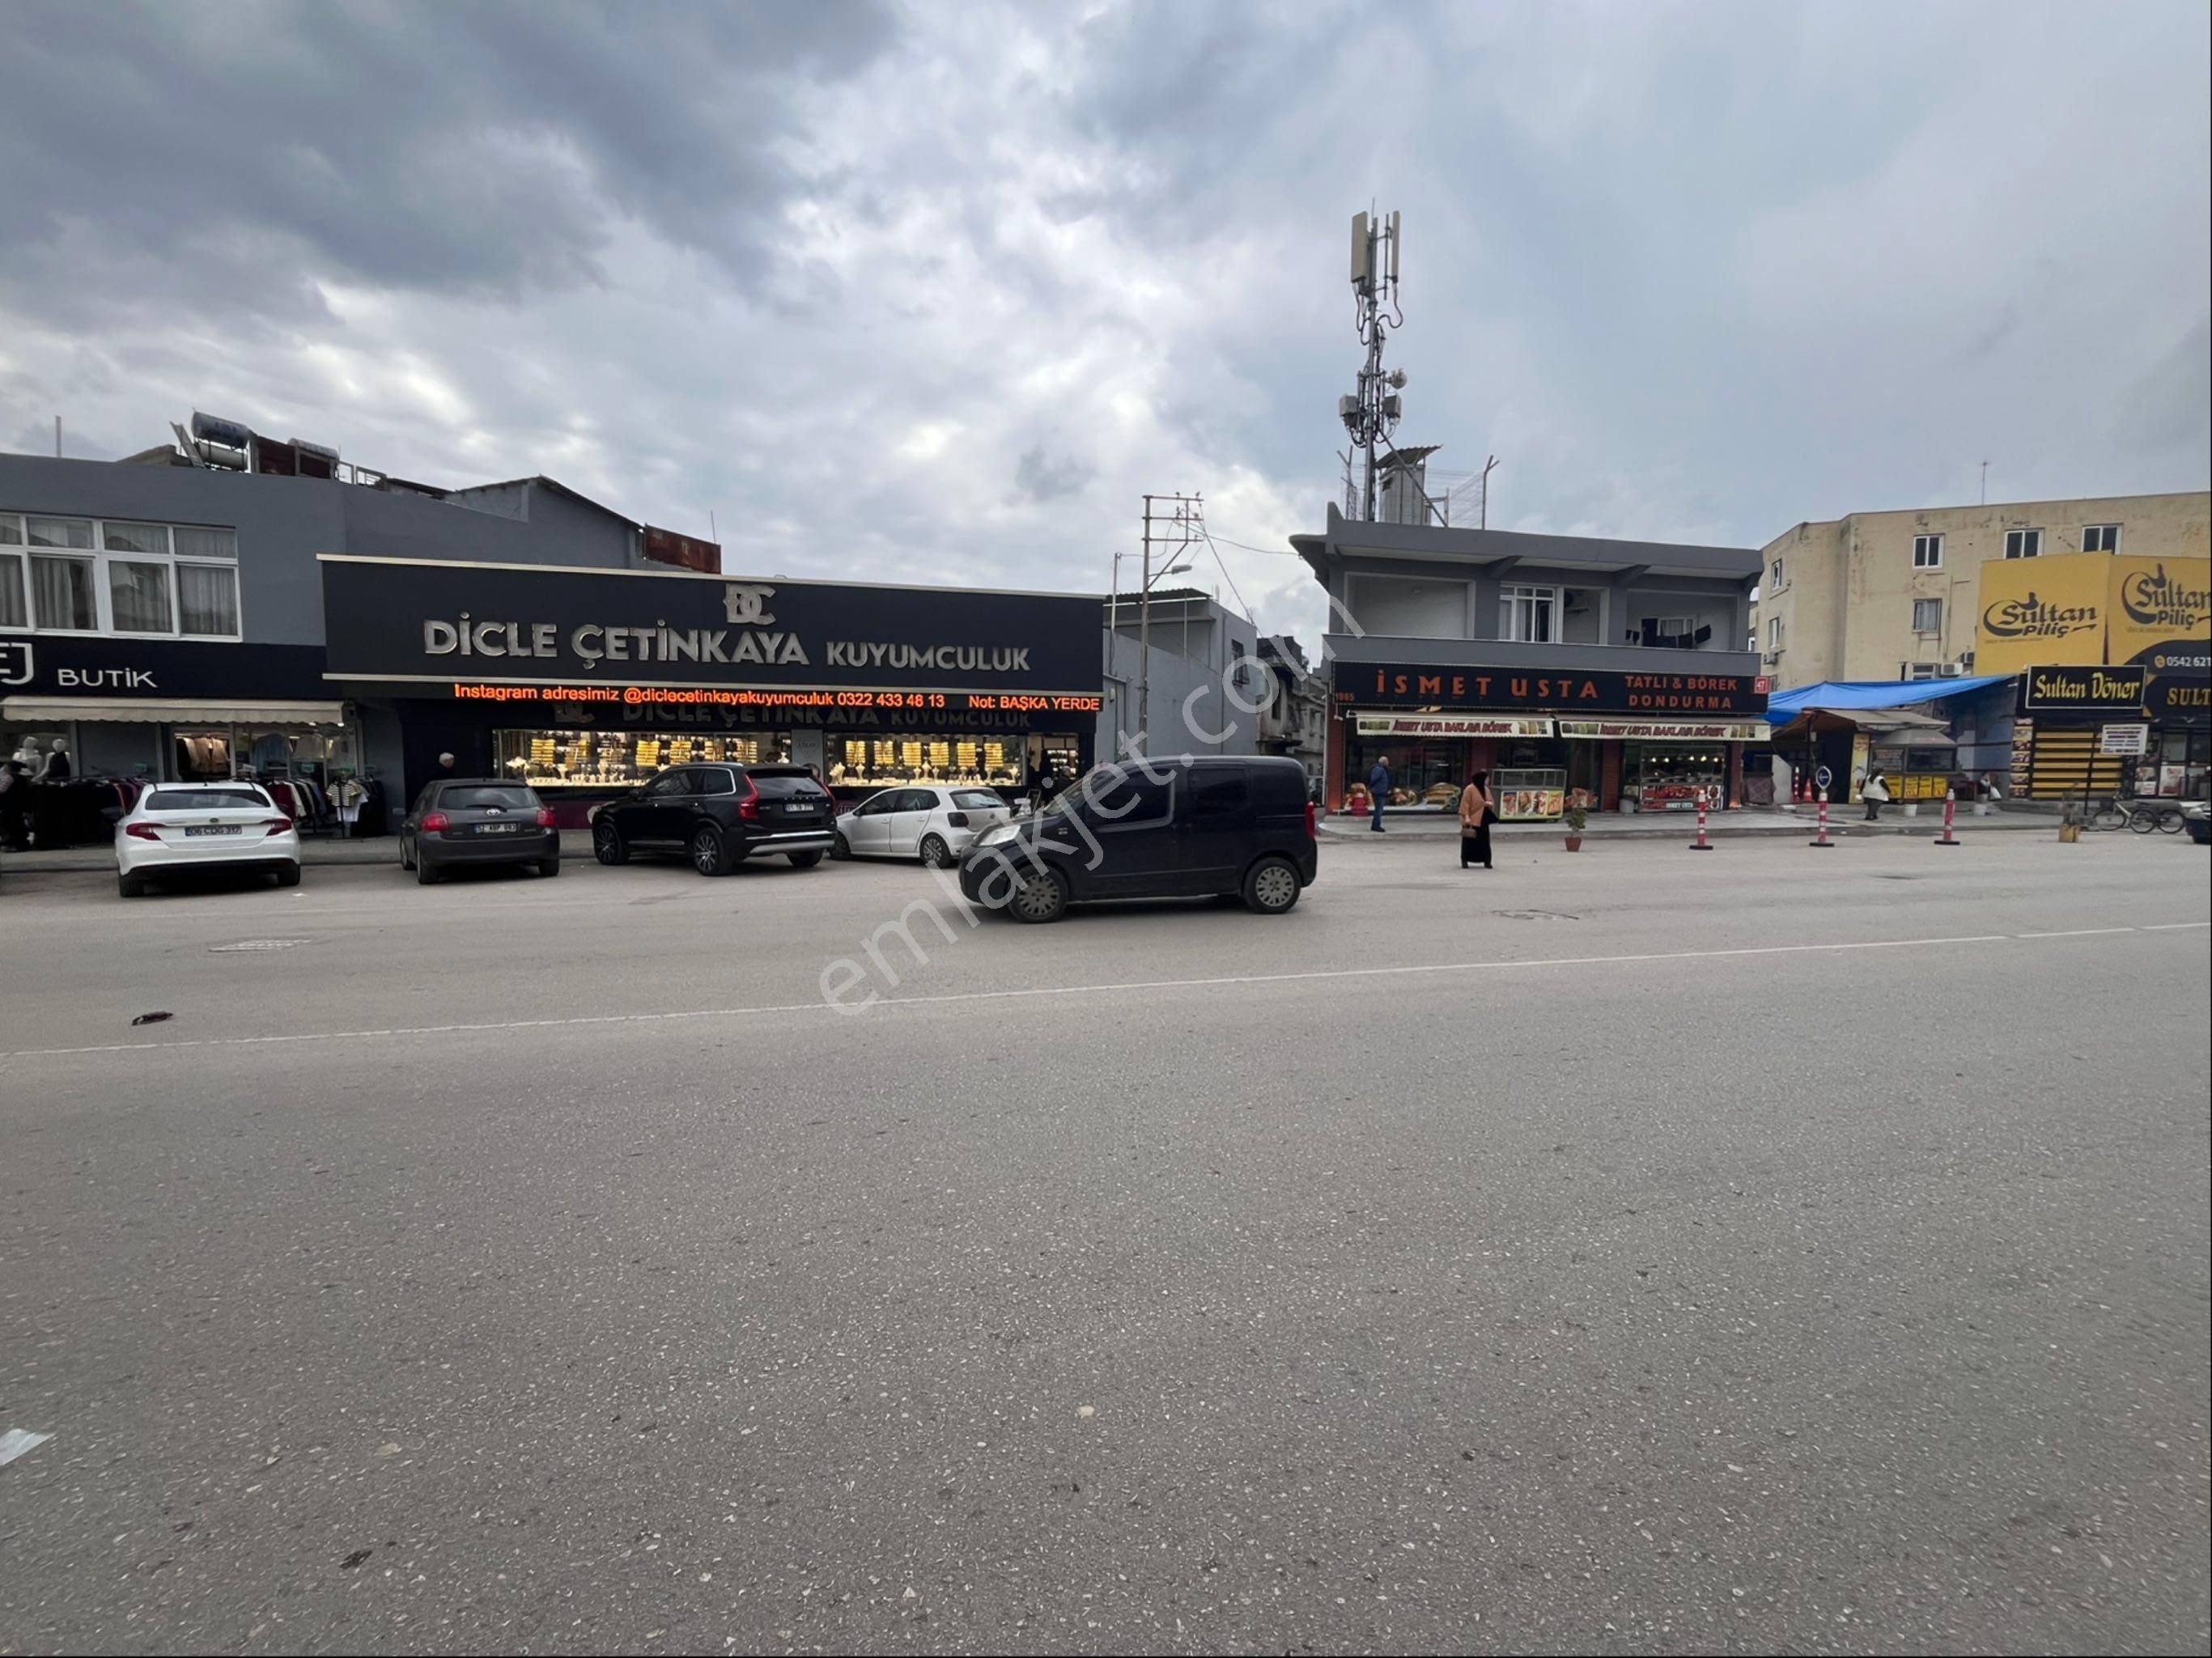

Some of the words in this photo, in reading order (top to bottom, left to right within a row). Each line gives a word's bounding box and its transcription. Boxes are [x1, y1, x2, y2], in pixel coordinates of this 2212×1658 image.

[1998, 601, 2098, 625] Sultan
[424, 611, 558, 657] DİCLE
[571, 619, 810, 670] ÇETİNKAYA
[826, 641, 1030, 672] KUYUMCULUK
[2167, 656, 2192, 667] 0542
[57, 668, 158, 688] BUTİK
[1377, 669, 1491, 697] İSMET
[1510, 677, 1598, 699] USTA
[1625, 675, 1667, 689] TATLI
[1672, 677, 1682, 689] &
[1688, 676, 1737, 691] BÖREK
[2033, 673, 2087, 700] Sultan
[2091, 672, 2141, 701] Döner
[454, 684, 537, 701] Instagram
[542, 686, 620, 701] adresimiz
[623, 687, 834, 706] @diclecetinkayakuyumculuk
[837, 693, 872, 706] 0322
[877, 693, 902, 706] 433
[906, 694, 924, 707] 48
[928, 694, 945, 707] 13
[969, 695, 996, 709] Not:
[1000, 696, 1048, 712] BAŞKA
[1051, 697, 1100, 710] YERDE
[1335, 692, 1355, 702] 1985
[1628, 694, 1731, 709] DONDURMA
[891, 708, 1030, 727] KUYUMCULUK
